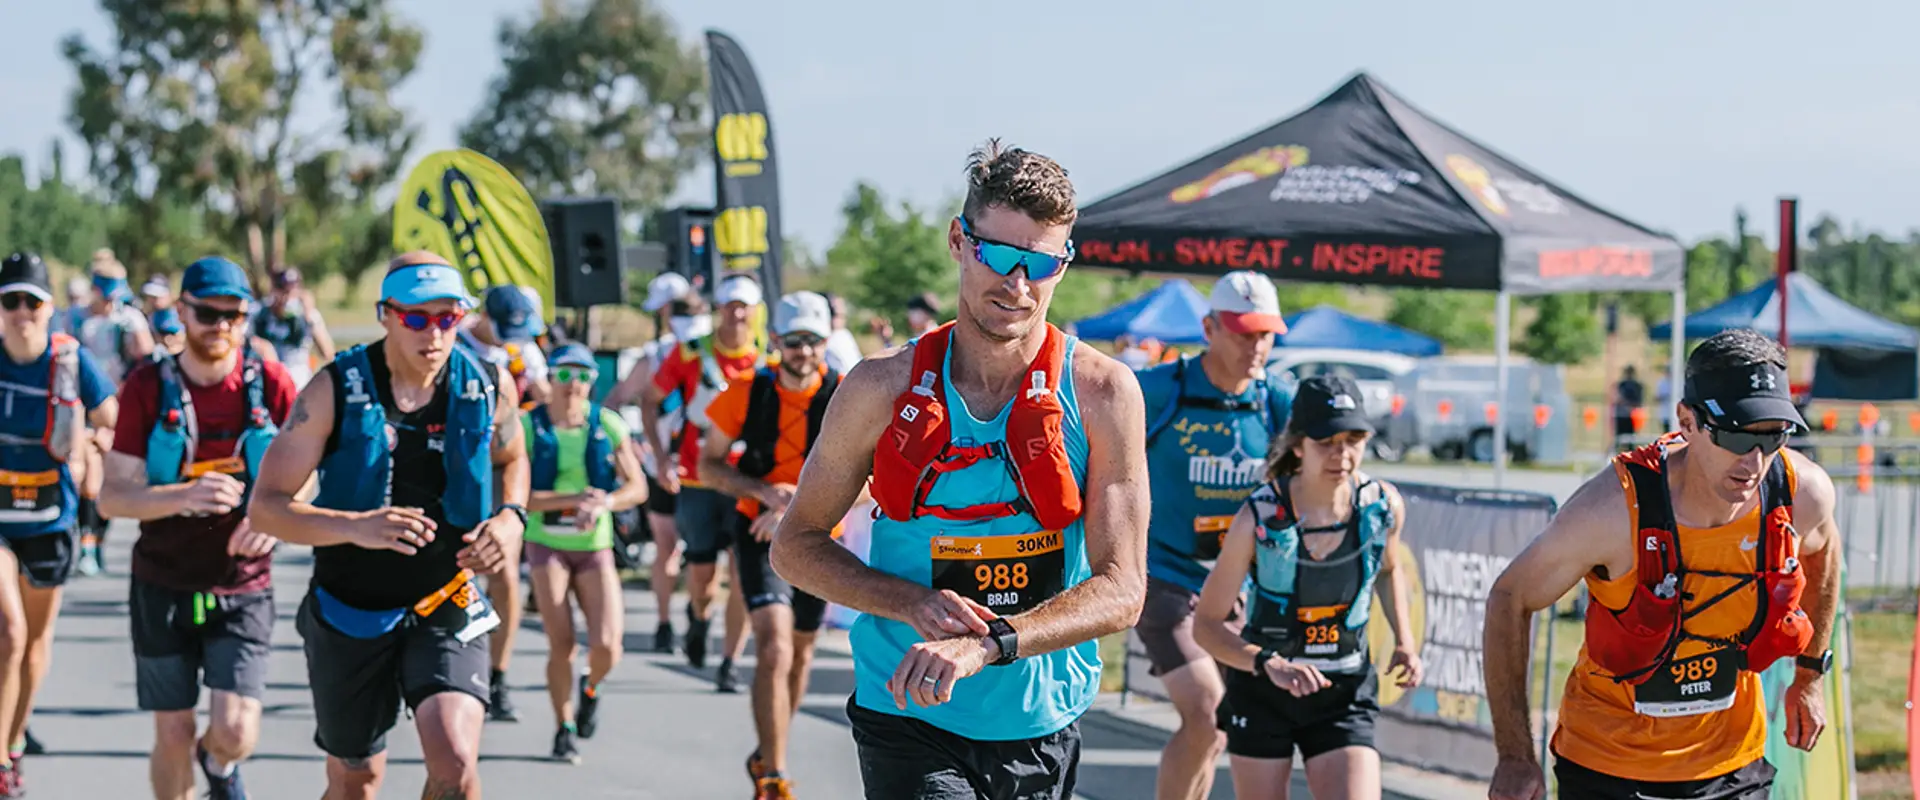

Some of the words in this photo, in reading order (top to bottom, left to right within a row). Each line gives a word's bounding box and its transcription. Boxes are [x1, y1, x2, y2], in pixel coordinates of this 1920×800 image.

[1174, 238, 1288, 270] SWEAT
[1311, 243, 1445, 279] INSPIRE
[1016, 532, 1060, 553] 30KM
[974, 562, 1030, 592] 988
[986, 591, 1020, 607] BRAD
[1305, 623, 1340, 645] 936
[1670, 656, 1718, 684] 989
[1680, 680, 1713, 696] PETER
